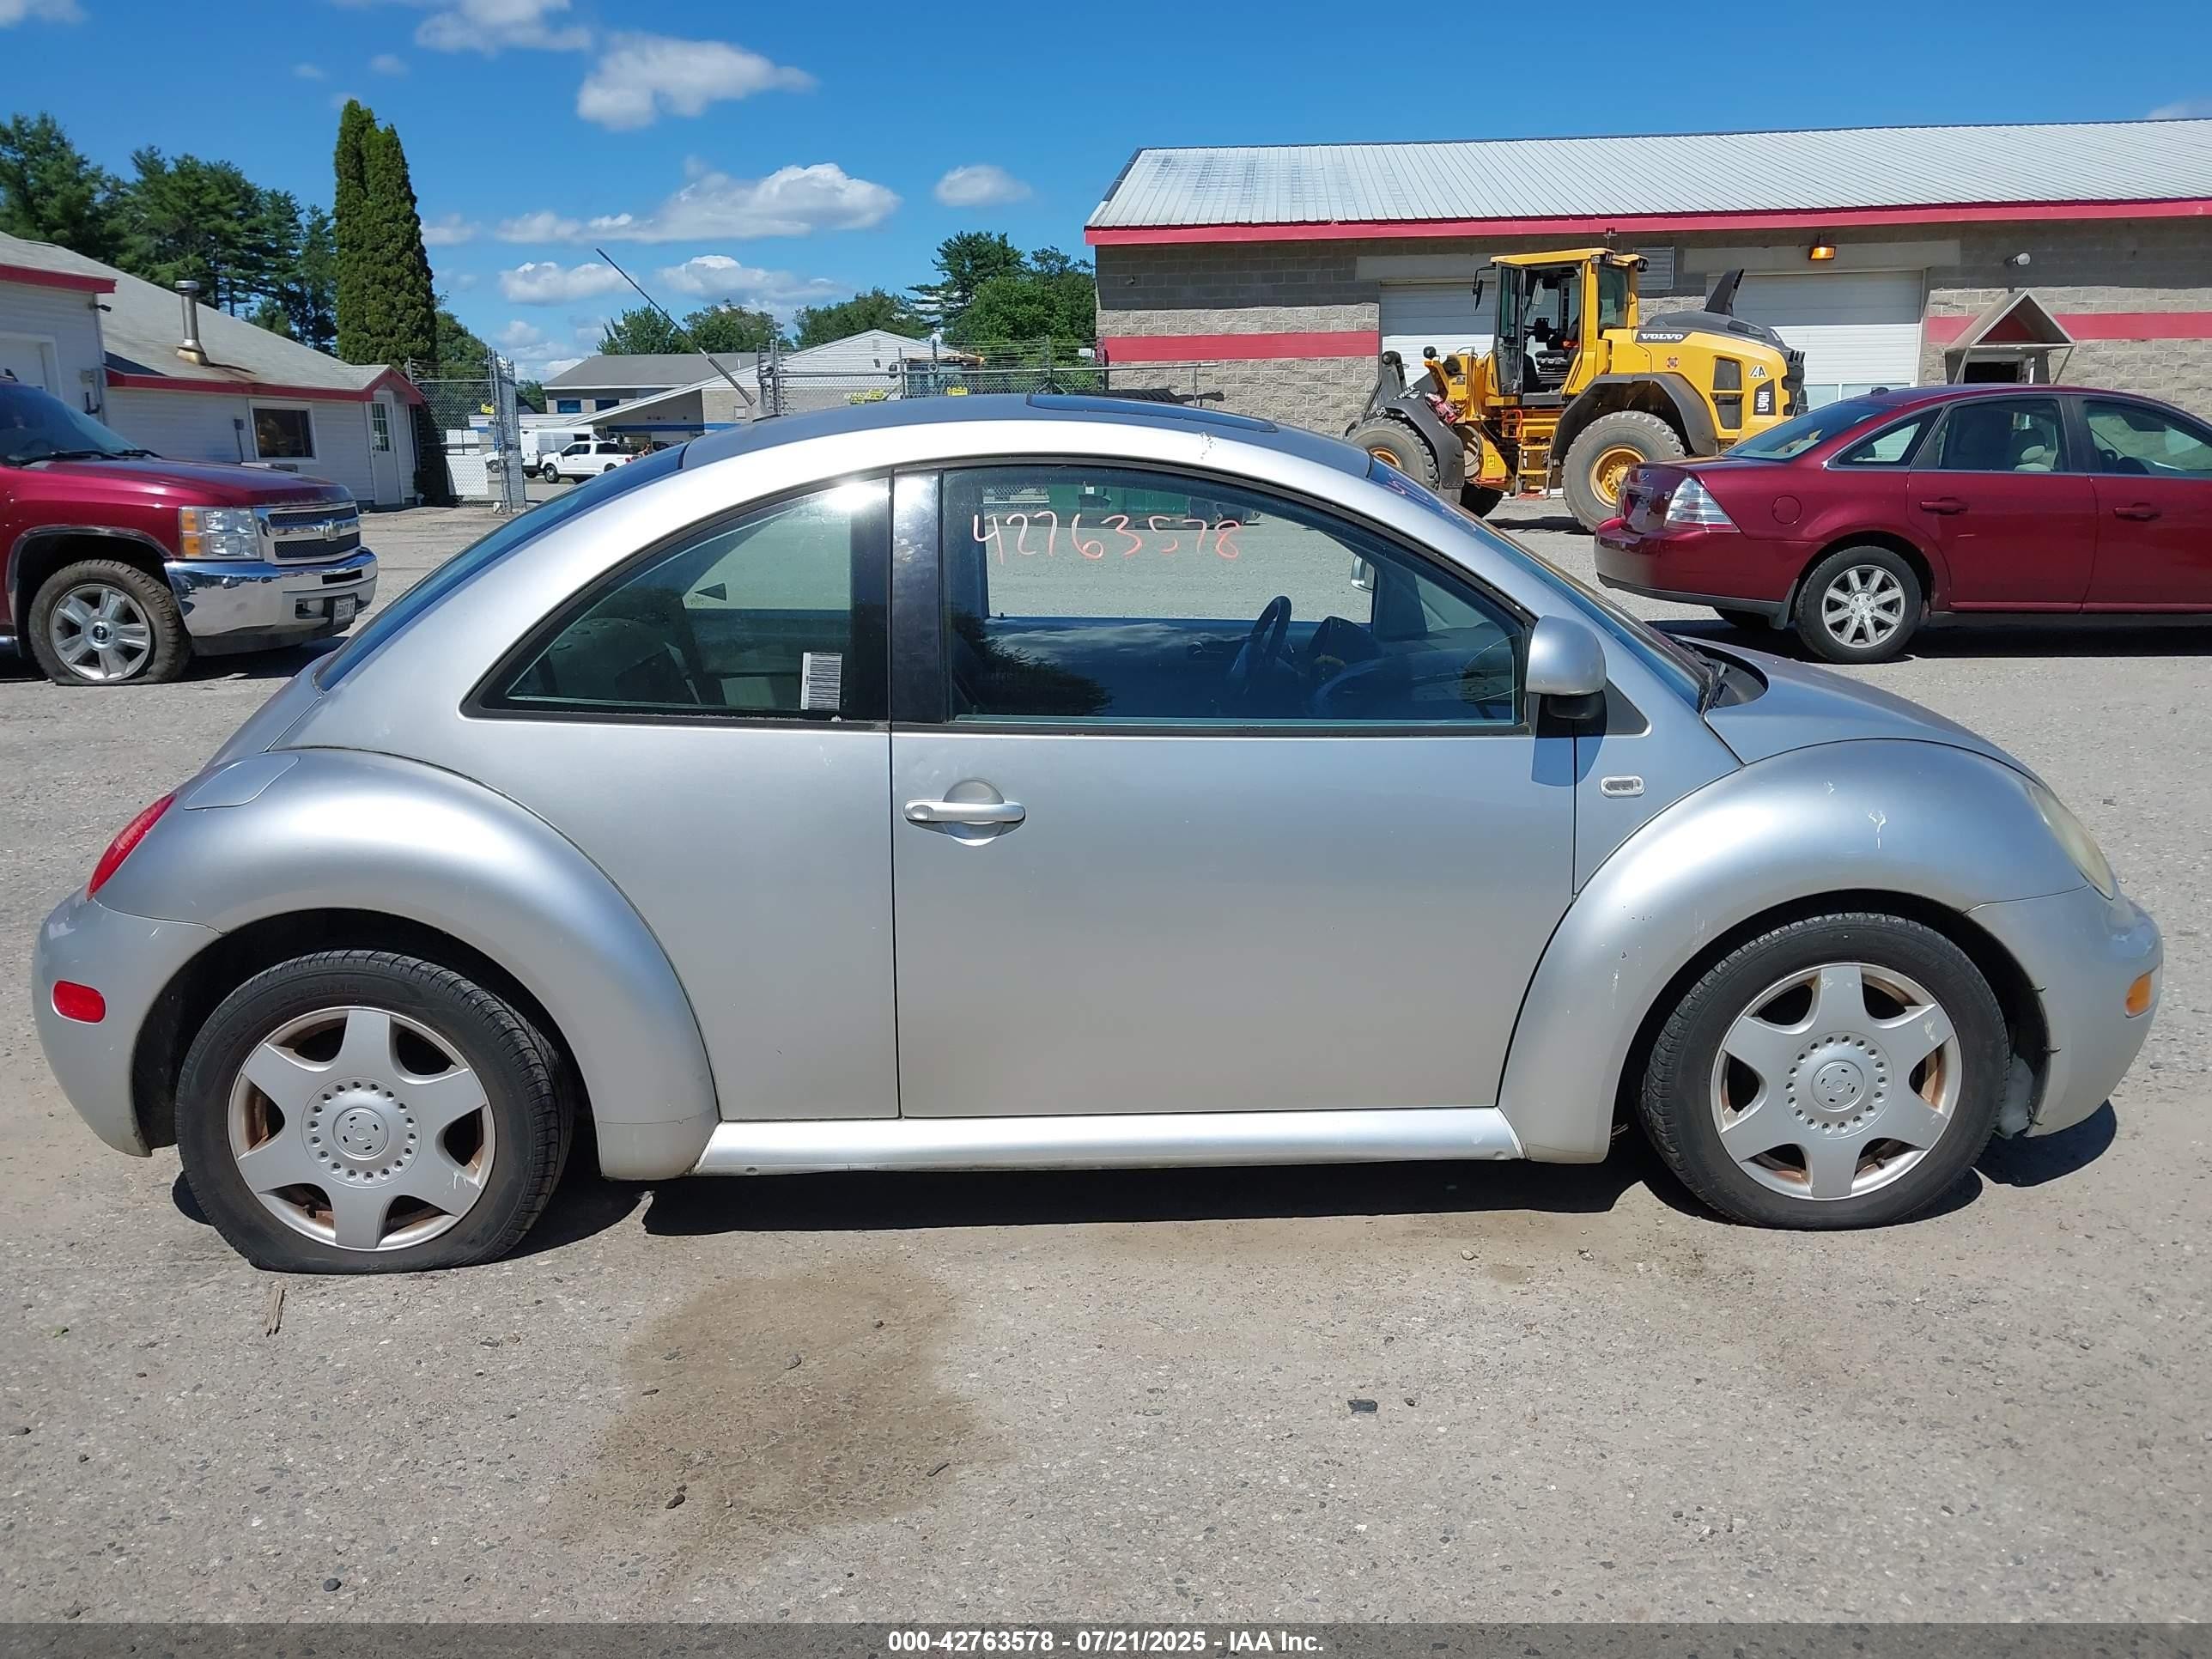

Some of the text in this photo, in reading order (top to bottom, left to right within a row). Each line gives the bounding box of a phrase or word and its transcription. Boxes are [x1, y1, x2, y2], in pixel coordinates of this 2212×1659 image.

[1397, 385, 1416, 399] WALK
[1757, 391, 1771, 412] L90H
[972, 510, 1241, 566] 42763578
